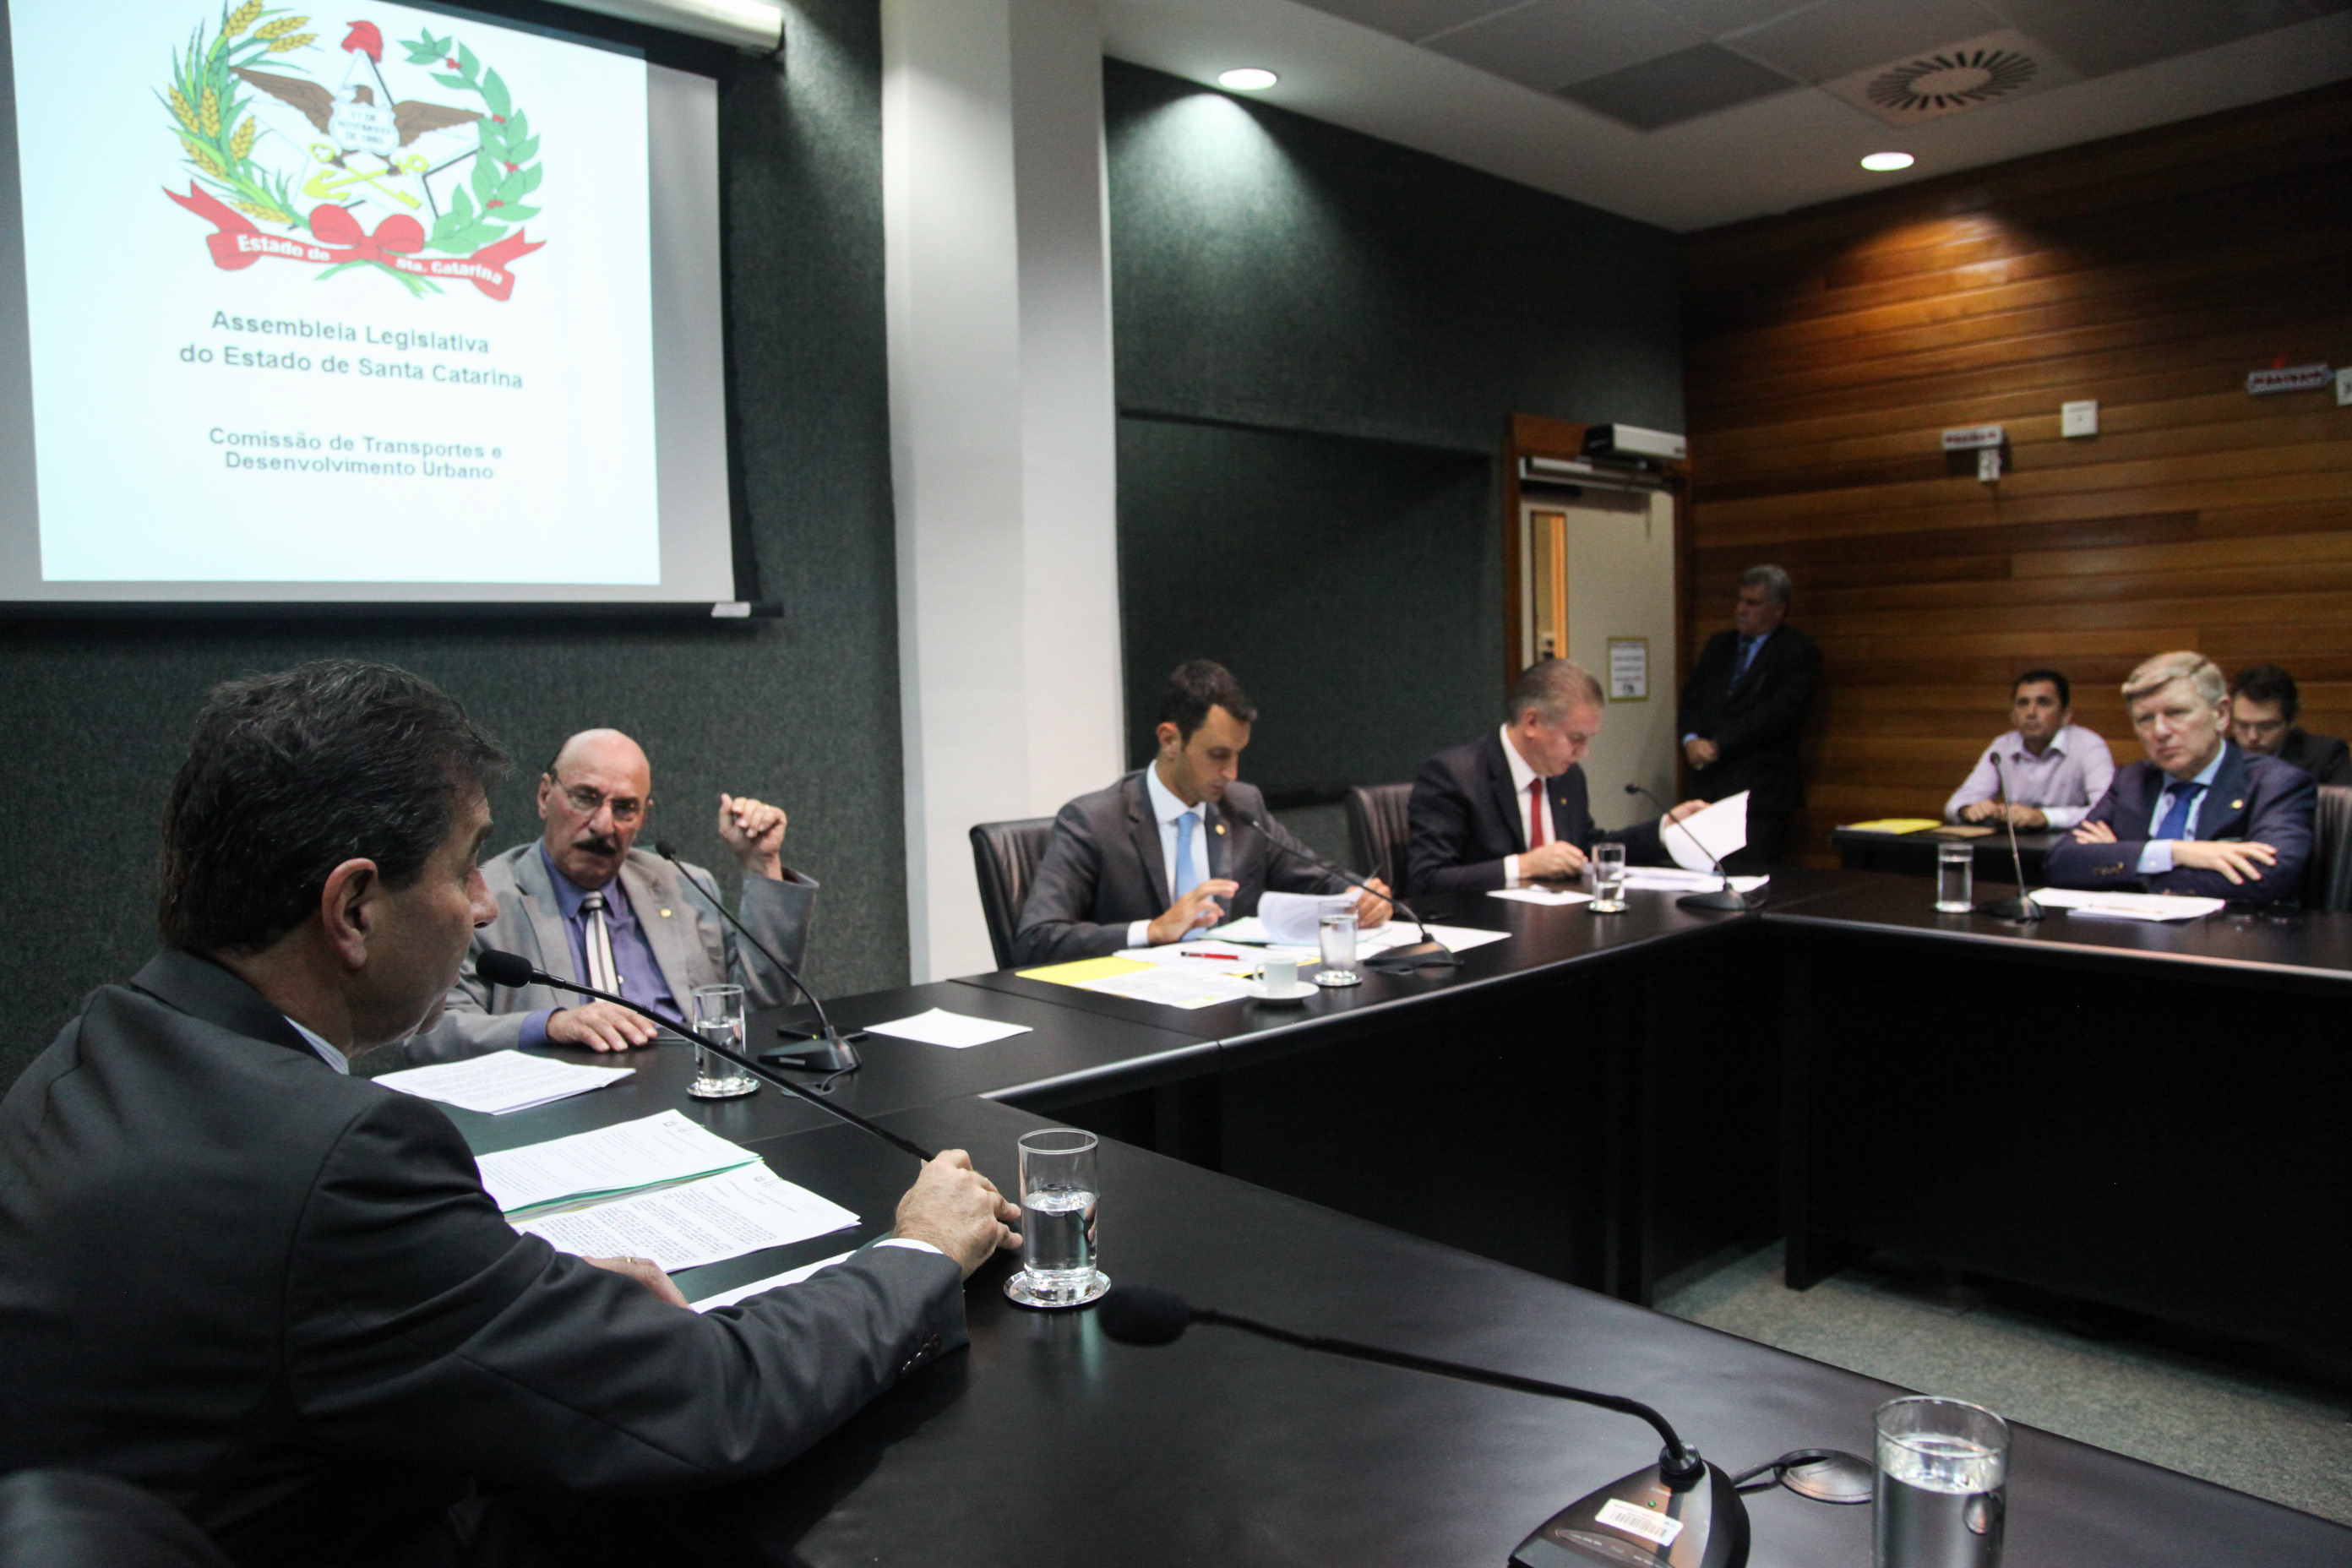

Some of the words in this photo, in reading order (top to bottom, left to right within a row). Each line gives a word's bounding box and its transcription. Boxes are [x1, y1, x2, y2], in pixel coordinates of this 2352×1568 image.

[237, 234, 303, 257] Estado
[308, 248, 330, 261] de
[395, 258, 427, 273] Sta.
[431, 260, 503, 286] Catarina
[211, 310, 357, 341] Assembleia
[366, 324, 489, 353] Legislativa
[179, 343, 214, 363] do
[223, 345, 312, 372] Estado
[321, 354, 350, 374] de
[358, 357, 424, 380] Santa
[432, 363, 523, 389] Catarina
[209, 427, 322, 450] Comissão
[329, 433, 355, 451] de
[362, 436, 485, 459] Transportes
[492, 446, 503, 459] e
[226, 450, 416, 476] Desenvolvimento
[422, 460, 494, 480] Urbano
